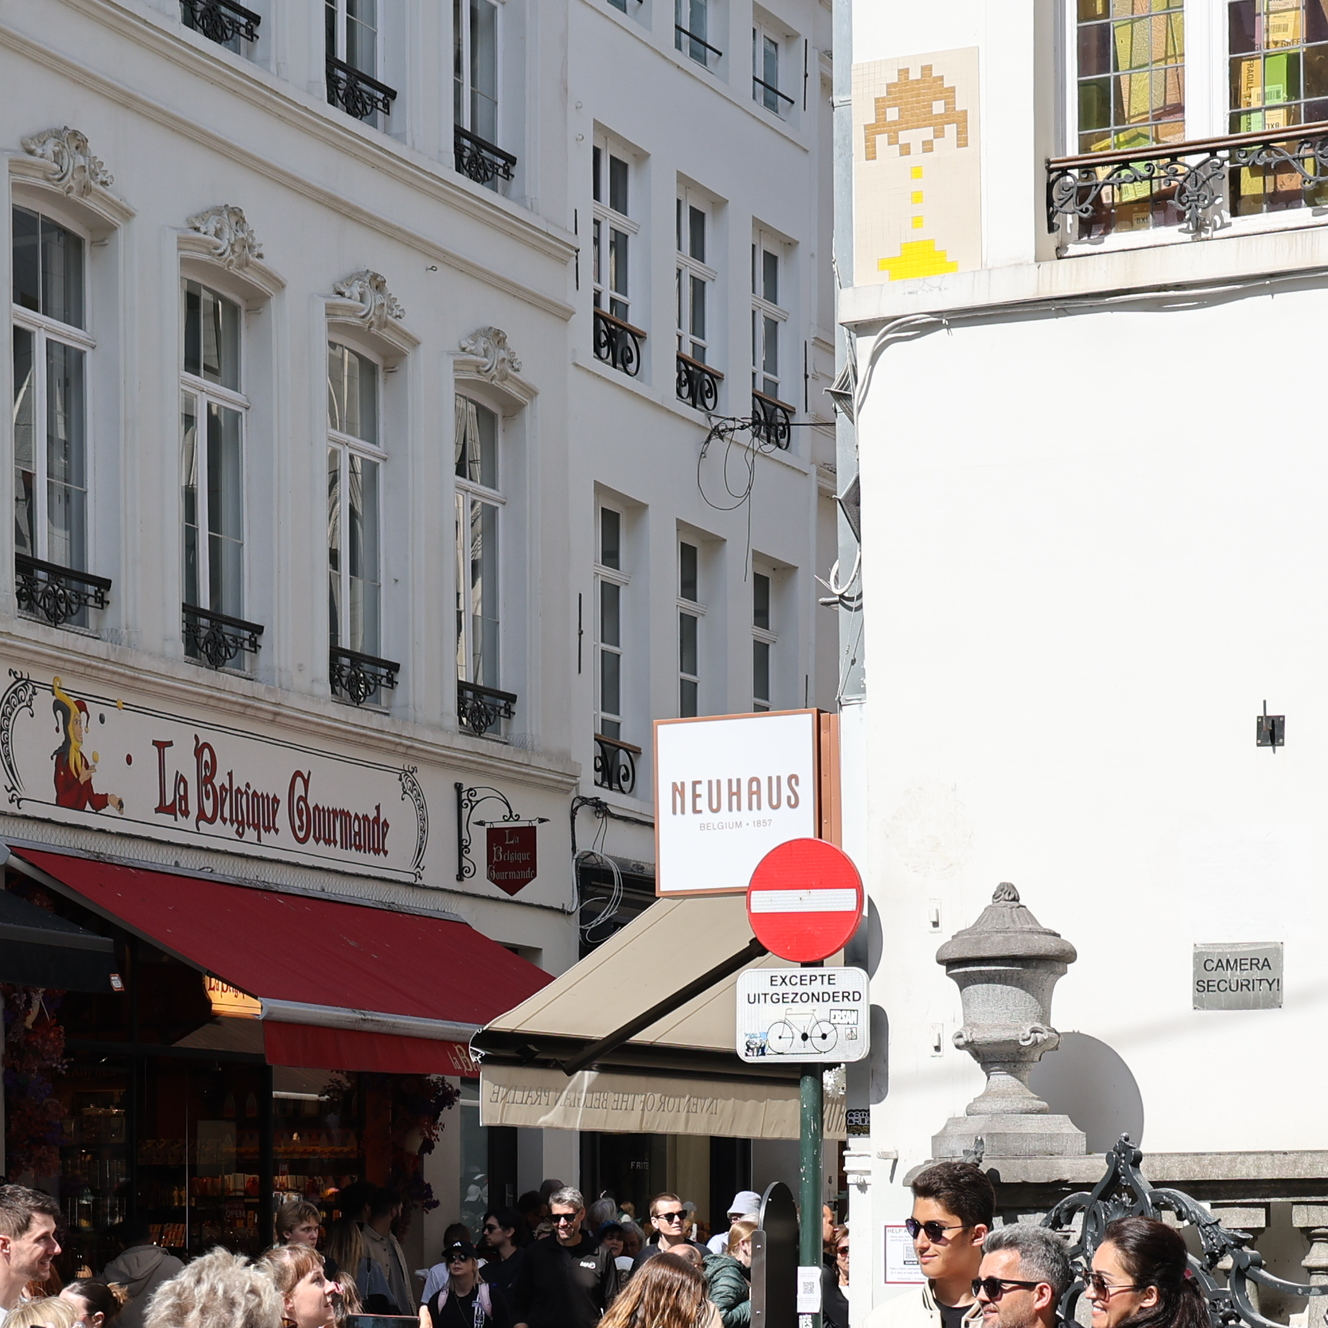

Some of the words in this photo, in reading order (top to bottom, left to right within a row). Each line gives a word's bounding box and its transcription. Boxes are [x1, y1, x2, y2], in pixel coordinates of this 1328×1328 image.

[152, 740, 190, 822] La
[194, 733, 280, 843] Belgique
[287, 769, 390, 857] Gourmande
[671, 773, 800, 815] NEUHAUS
[699, 820, 743, 831] BELGIUM
[753, 818, 773, 828] 1857
[493, 843, 530, 864] Belgique
[488, 864, 534, 881] Gourmande
[1203, 957, 1272, 972] CAMERA
[770, 974, 836, 986] EXCEPTE
[1195, 977, 1280, 993] SECURITY!
[747, 990, 862, 1005] UITGEZONDERD
